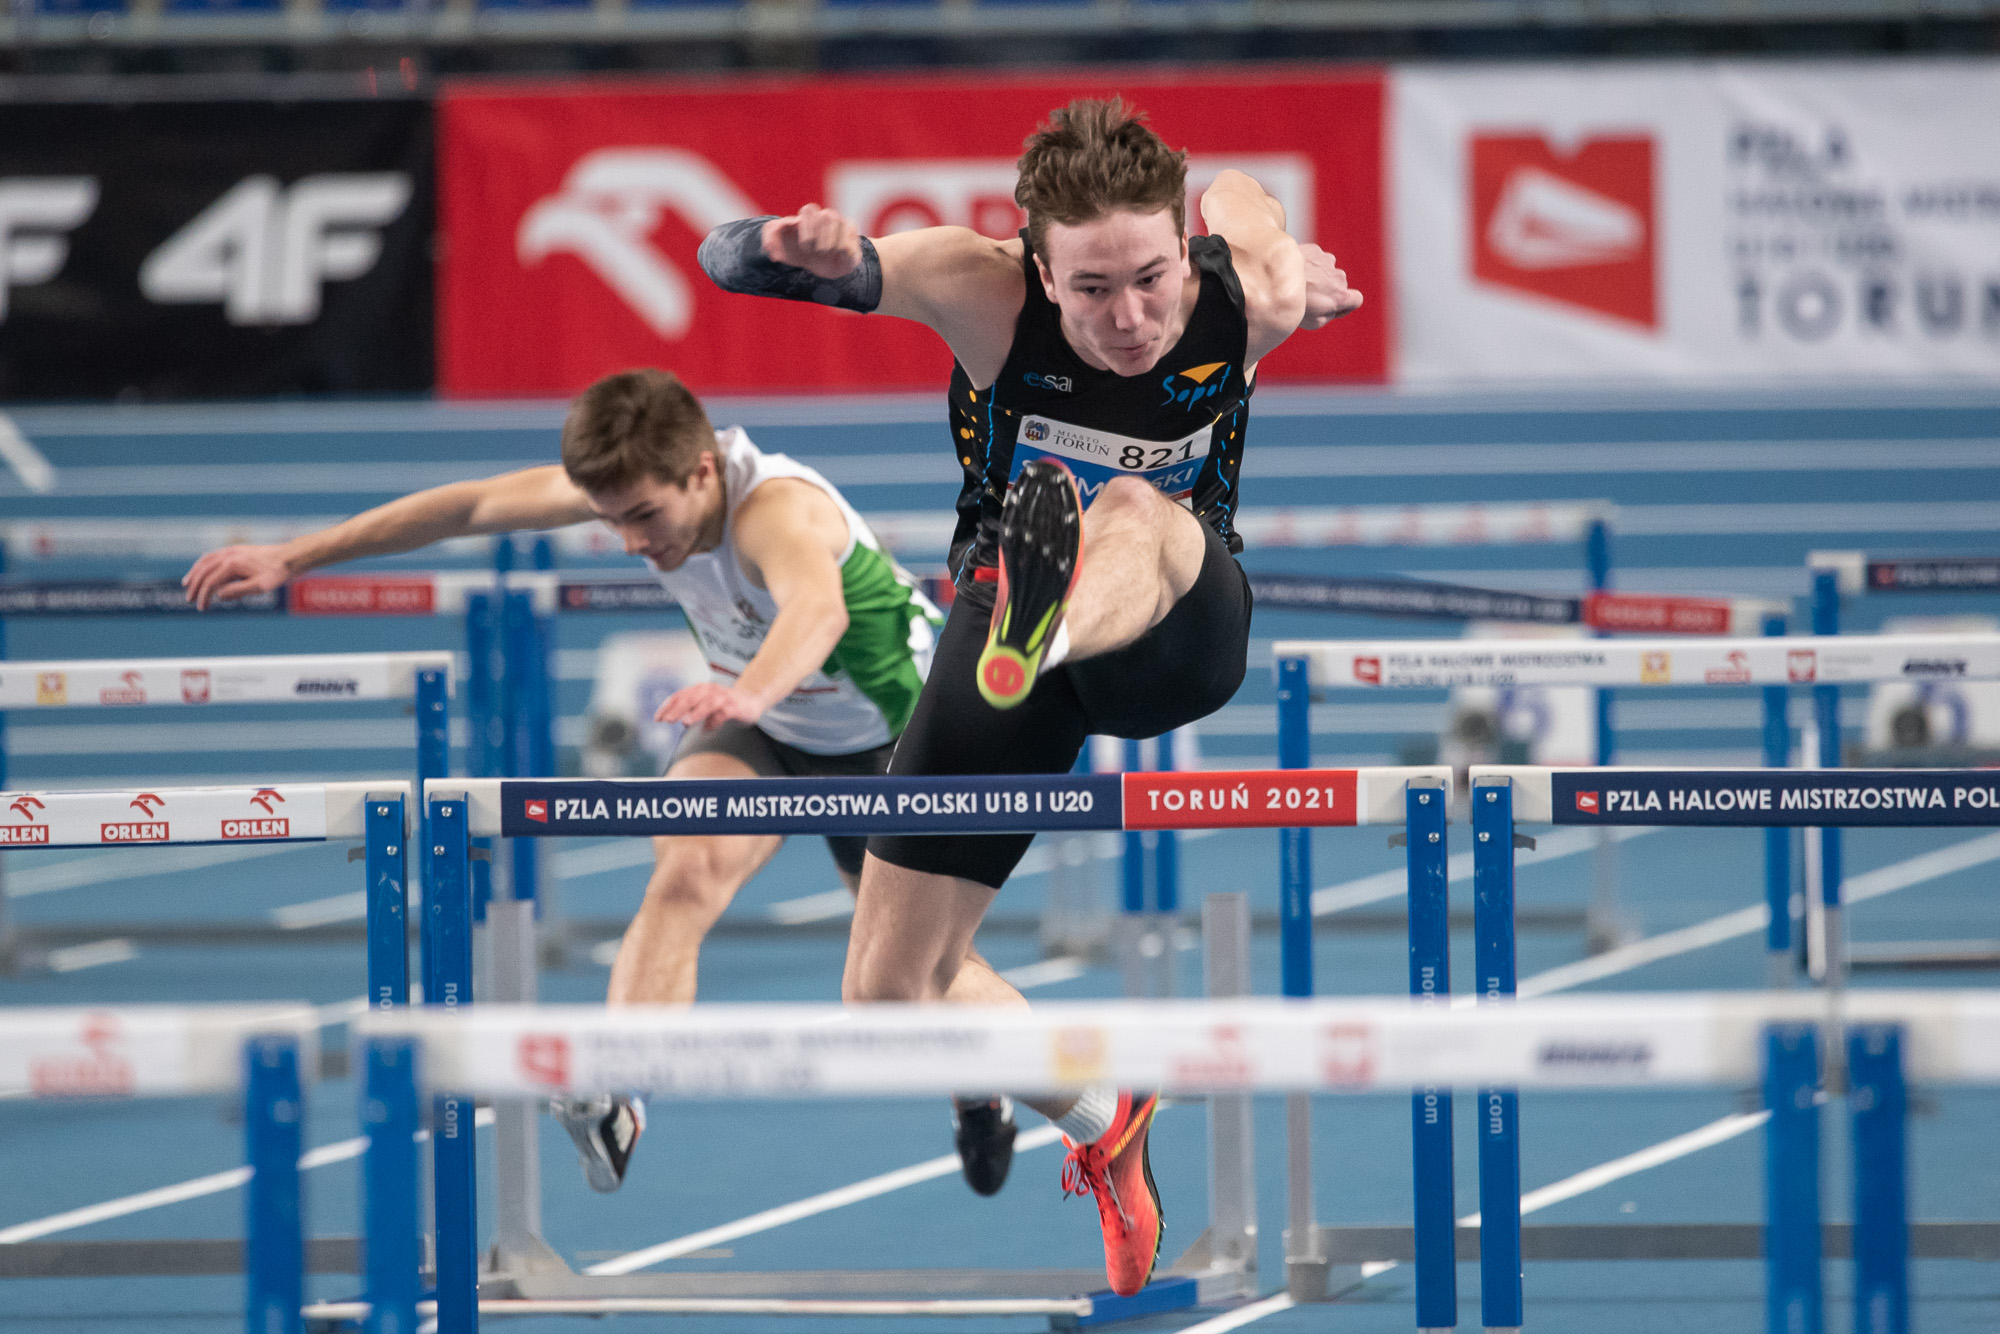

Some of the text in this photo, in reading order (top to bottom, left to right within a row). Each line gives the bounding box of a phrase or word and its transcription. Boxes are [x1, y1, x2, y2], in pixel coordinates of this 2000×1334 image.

[0, 175, 99, 322] F
[139, 172, 413, 326] 4F
[1160, 364, 1232, 412] Sopot
[1053, 434, 1111, 457] TORUŃ
[1057, 429, 1100, 445] MIASTO
[1118, 439, 1195, 471] 821
[554, 791, 1094, 820] PZLA HALOWE MISTRZOSTWA POLSKI U18 I U20
[1148, 783, 1335, 811] TORUŃ 2021
[1606, 787, 2000, 811] PZLA HALOWE MISTRZOSTWA POL
[0, 827, 46, 842] RLEN
[104, 823, 166, 841] ORLEN
[224, 819, 287, 837] ORLEN
